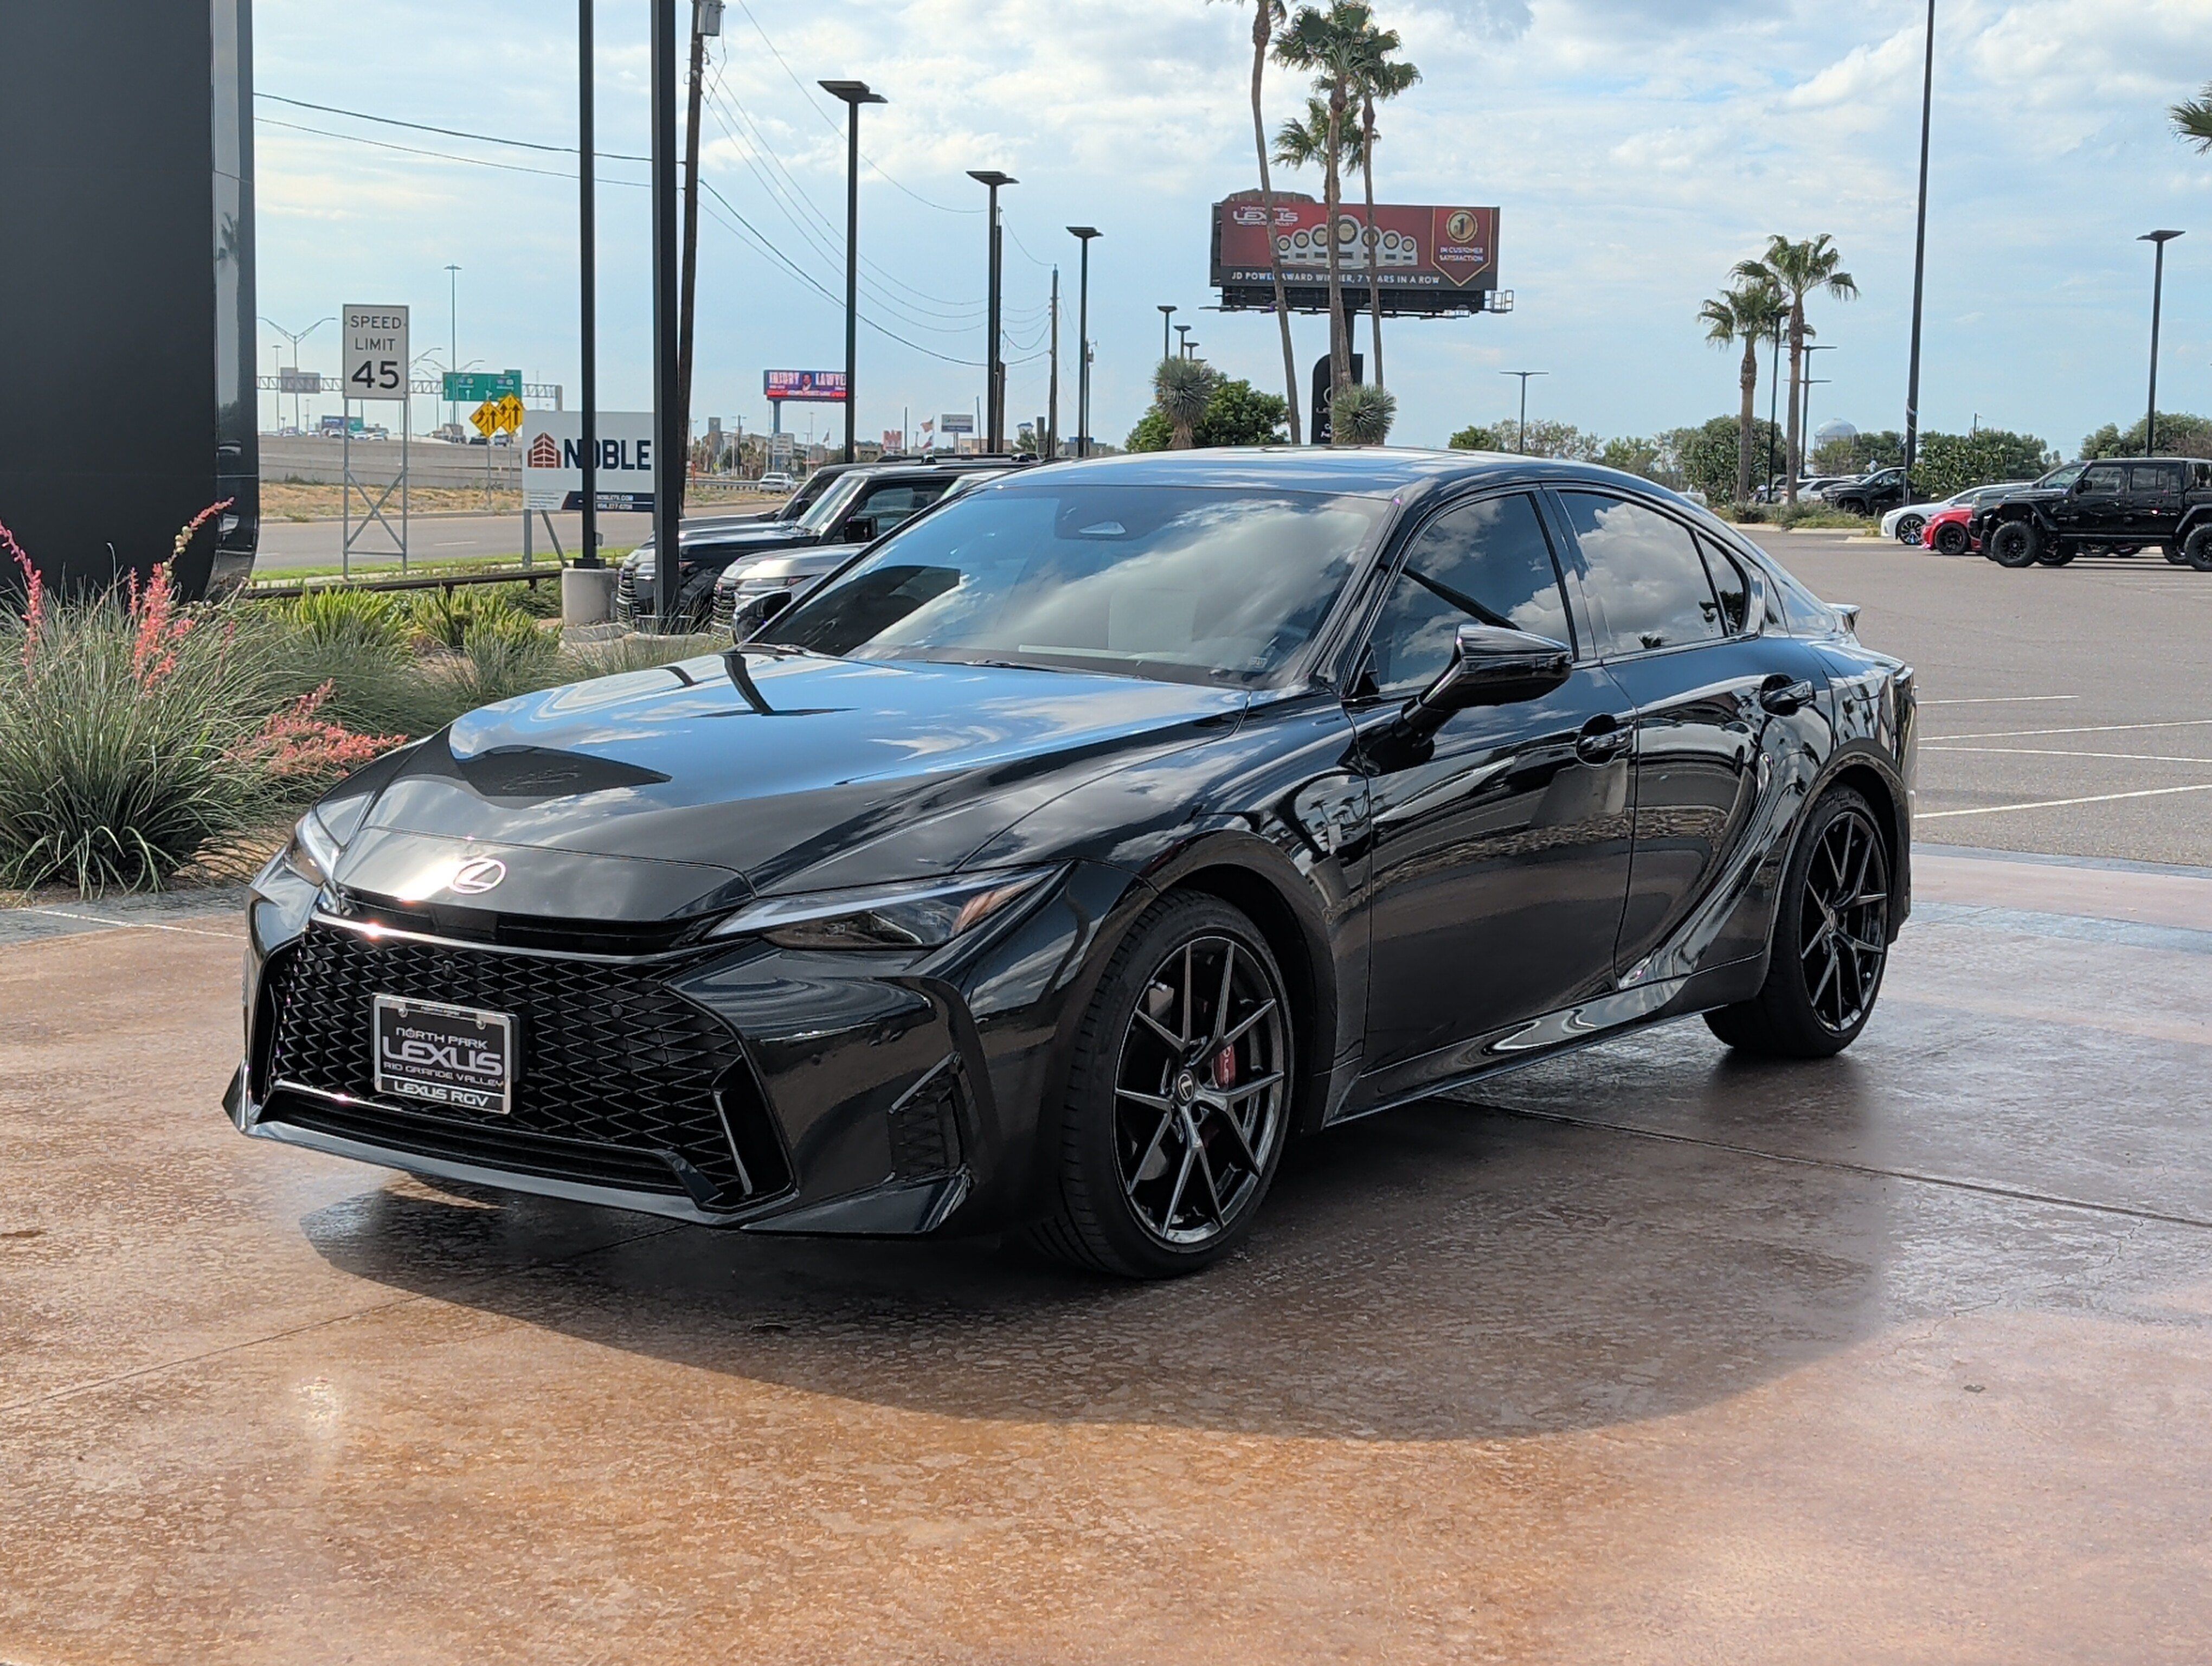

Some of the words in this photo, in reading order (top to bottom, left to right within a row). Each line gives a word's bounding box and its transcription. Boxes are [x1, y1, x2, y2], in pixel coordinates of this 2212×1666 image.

[1358, 274, 1363, 283] 7
[1366, 274, 1394, 283] YARS
[1397, 275, 1407, 283] IN
[1410, 275, 1417, 284] A
[1418, 276, 1440, 284] ROW
[350, 315, 402, 329] SPEED
[355, 337, 396, 351] LIMIT
[351, 360, 400, 389] 45
[396, 1027, 445, 1043] NORTH
[448, 1035, 488, 1050] PARK
[382, 1036, 503, 1076] LEXUS
[383, 1061, 403, 1071] RIO
[405, 1066, 454, 1081] GRANDE
[456, 1073, 504, 1087] VALLEY
[394, 1081, 448, 1100] LEXUS
[451, 1090, 489, 1107] RGV
